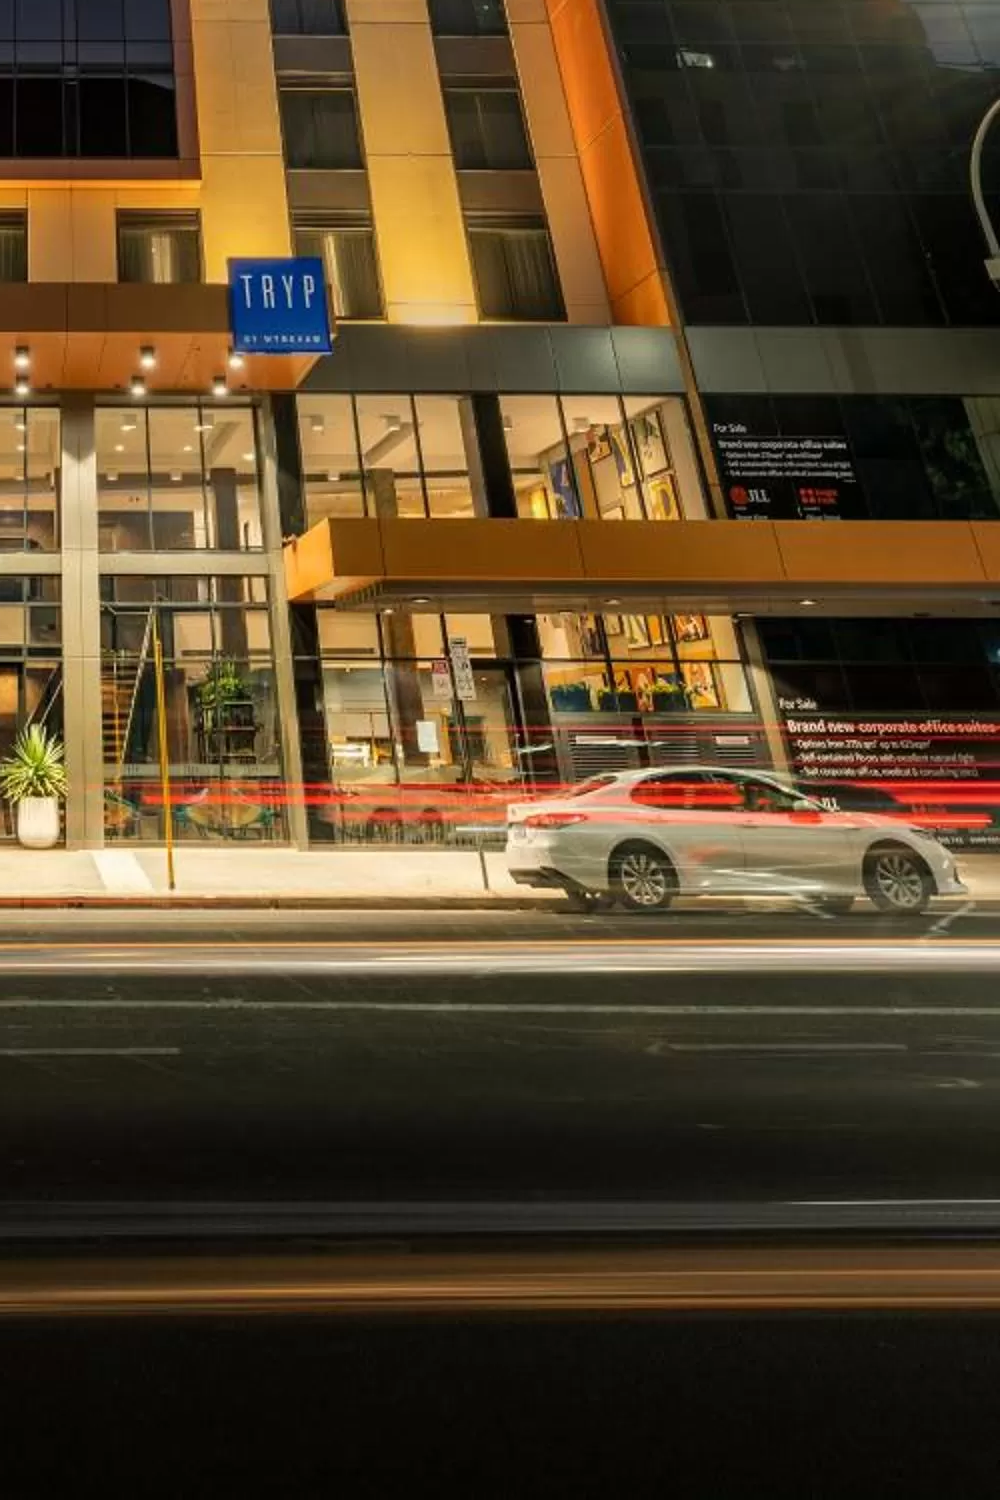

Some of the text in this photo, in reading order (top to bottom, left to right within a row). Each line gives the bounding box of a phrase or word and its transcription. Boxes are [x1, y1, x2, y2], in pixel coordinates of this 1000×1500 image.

[240, 275, 315, 308] TRYP
[779, 698, 817, 710] For Sale
[787, 719, 997, 736] Brand new corporate office suites
